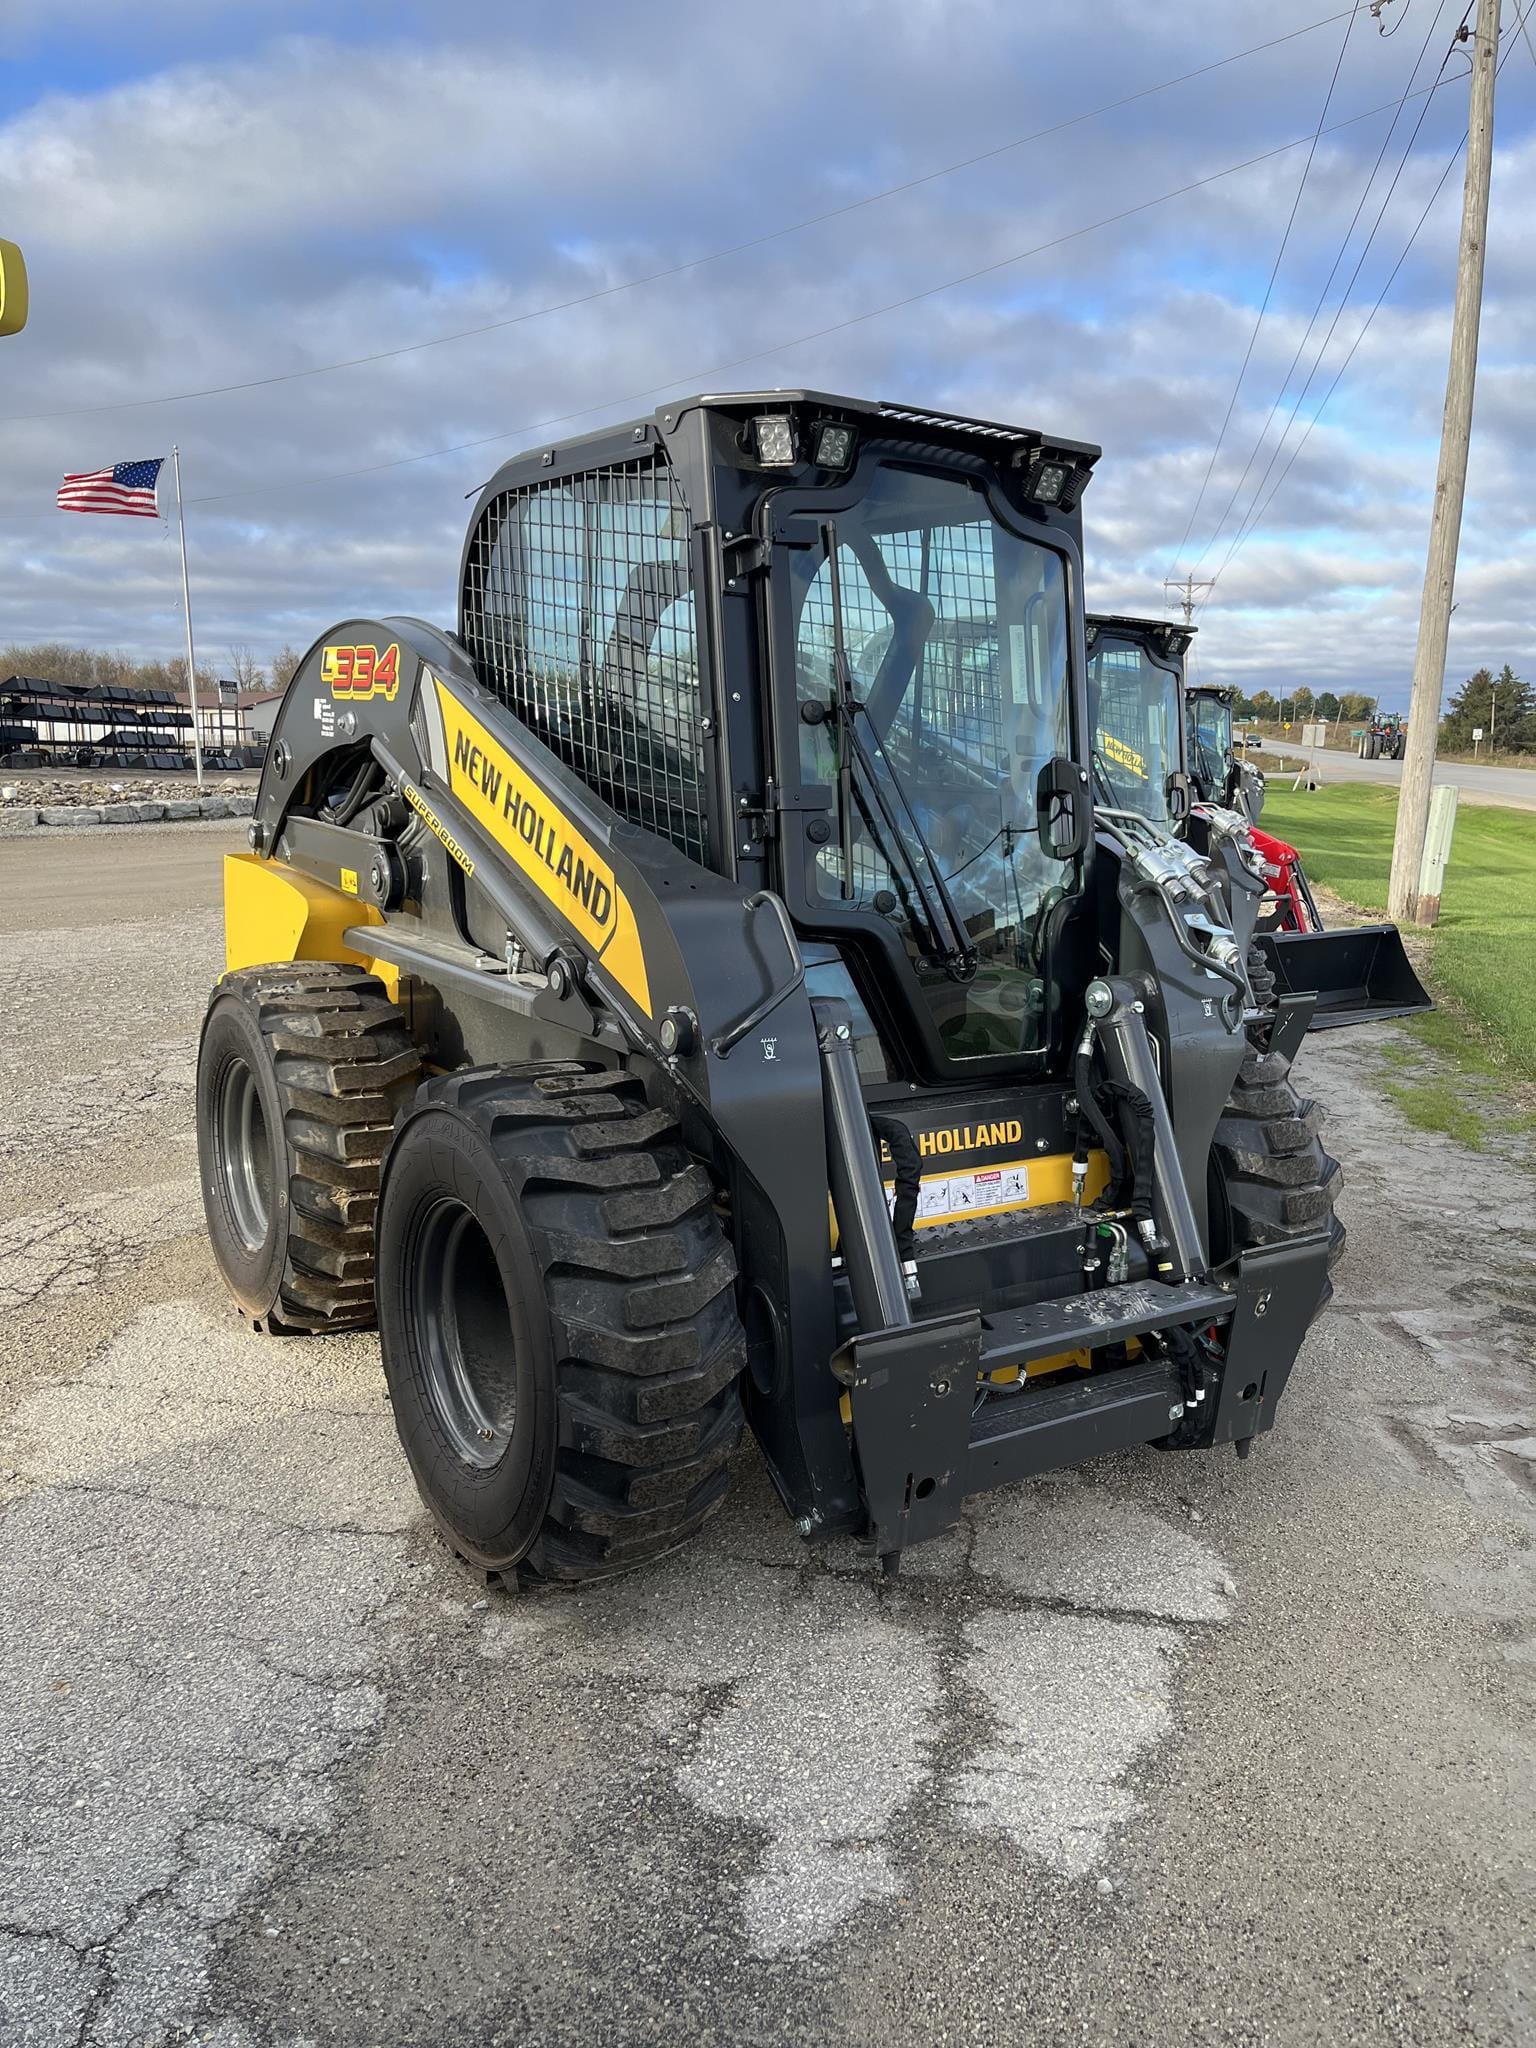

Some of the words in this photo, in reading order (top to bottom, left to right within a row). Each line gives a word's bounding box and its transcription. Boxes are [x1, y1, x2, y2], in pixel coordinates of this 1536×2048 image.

[321, 643, 400, 701] L334
[405, 785, 441, 832] SUPER
[440, 828, 474, 875] BOOM
[453, 727, 502, 805] NEW
[503, 781, 611, 927] HOLLAND
[919, 1120, 1022, 1157] HOLLAND
